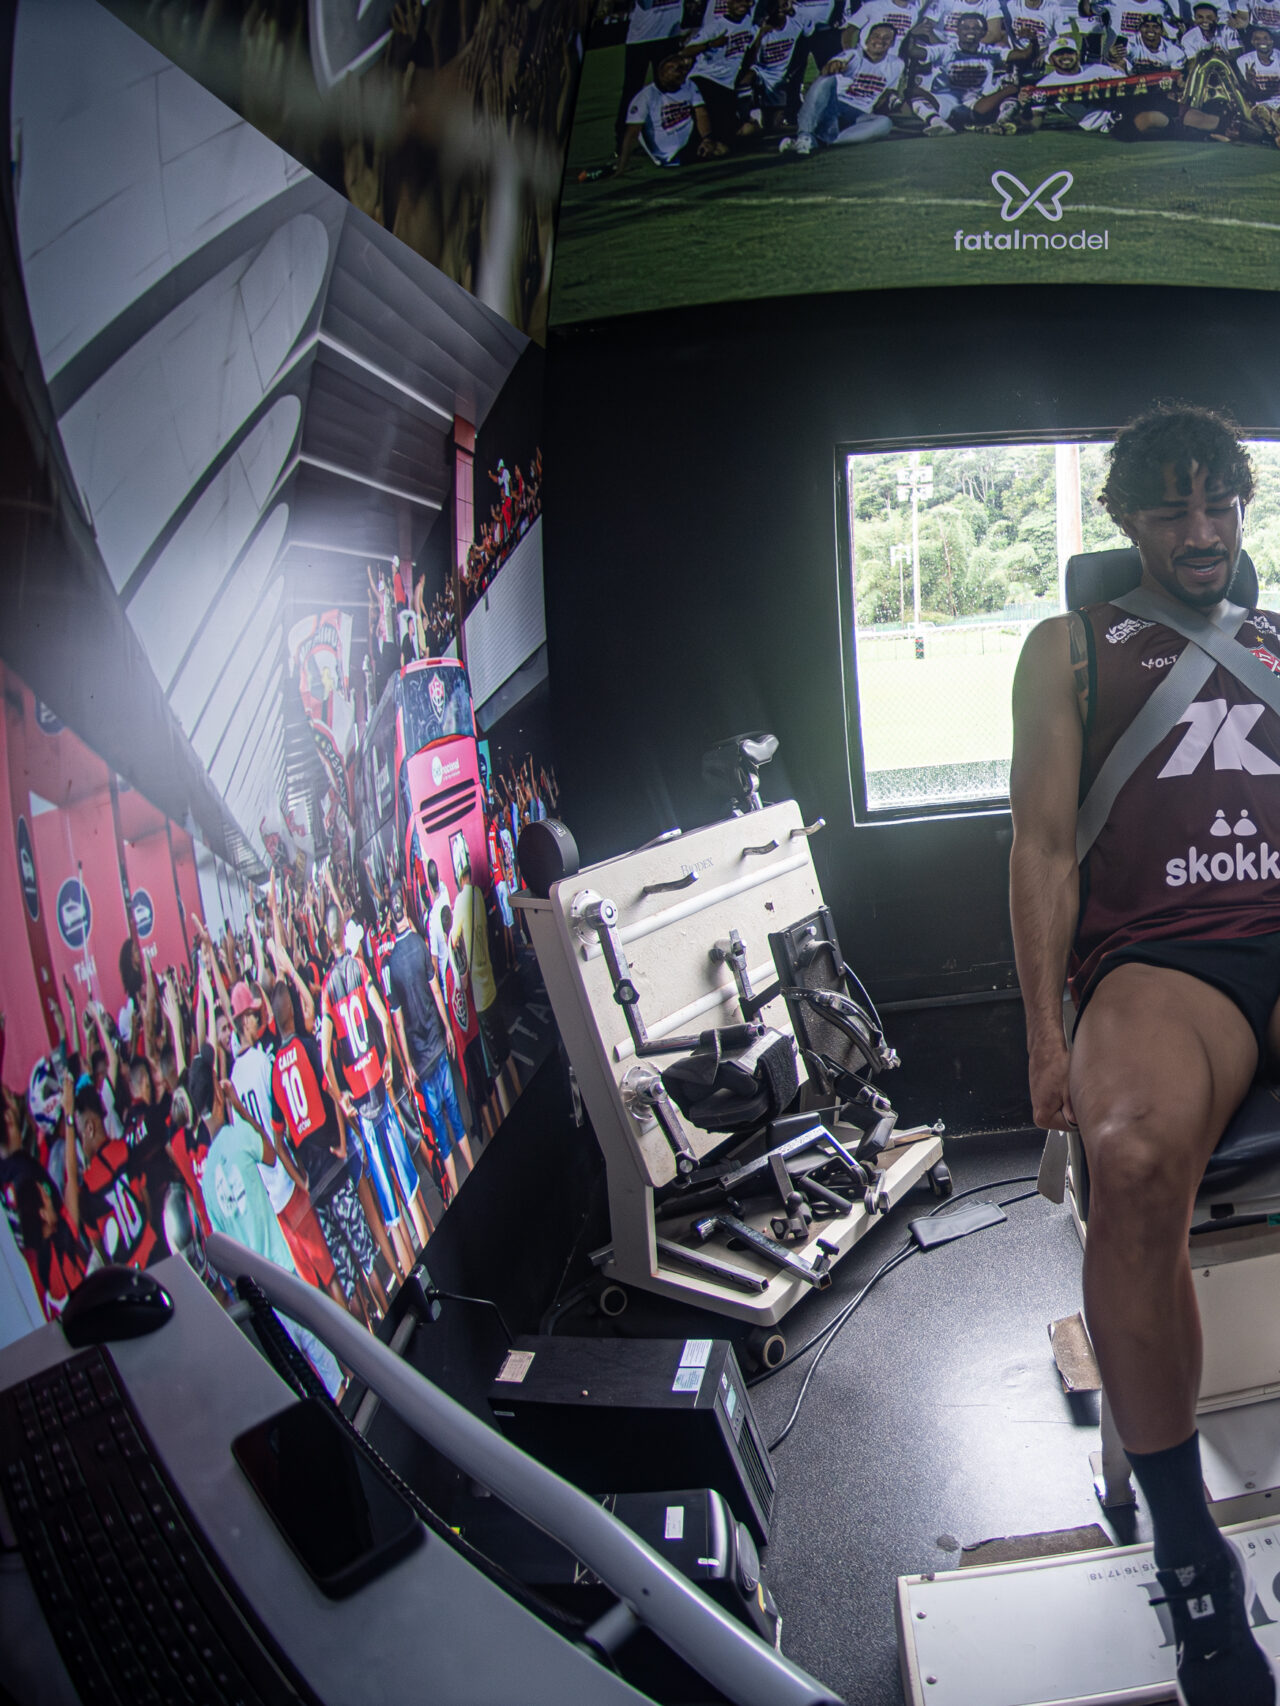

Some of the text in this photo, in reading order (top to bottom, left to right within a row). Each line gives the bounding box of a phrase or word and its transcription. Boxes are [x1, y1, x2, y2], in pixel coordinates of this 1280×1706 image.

[1057, 77, 1149, 104] SERIE A
[954, 228, 1109, 252] fatalmodel
[1141, 654, 1178, 670] VOLT
[339, 994, 369, 1059] 10
[281, 1064, 309, 1125] 10
[104, 1172, 143, 1251] 10
